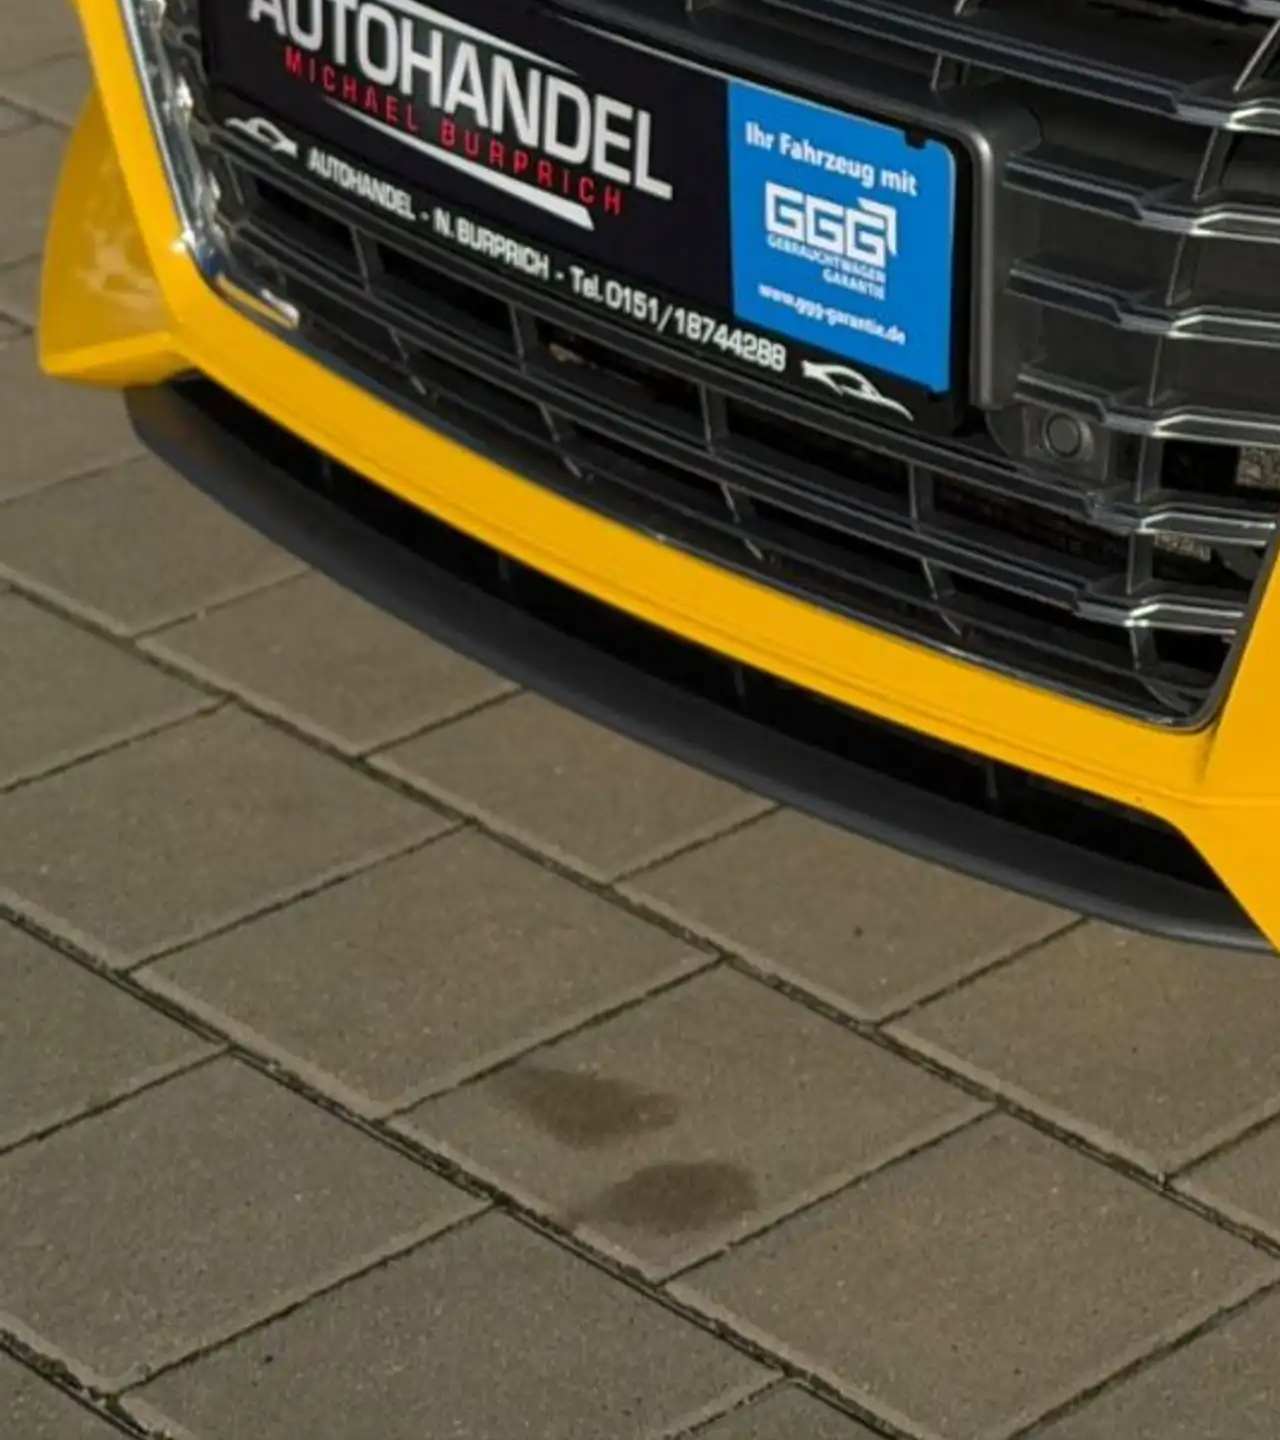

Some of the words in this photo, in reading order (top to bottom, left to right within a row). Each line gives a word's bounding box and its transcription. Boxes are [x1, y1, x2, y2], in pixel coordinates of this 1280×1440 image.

[285, 45, 420, 133] MICHAEL
[440, 120, 623, 216] BURPRICH
[744, 120, 775, 151] Ihr
[779, 131, 875, 189] Fahrzeug
[881, 167, 918, 197] mit
[307, 146, 417, 222] AUTOHANDEL
[764, 180, 886, 270] GGG
